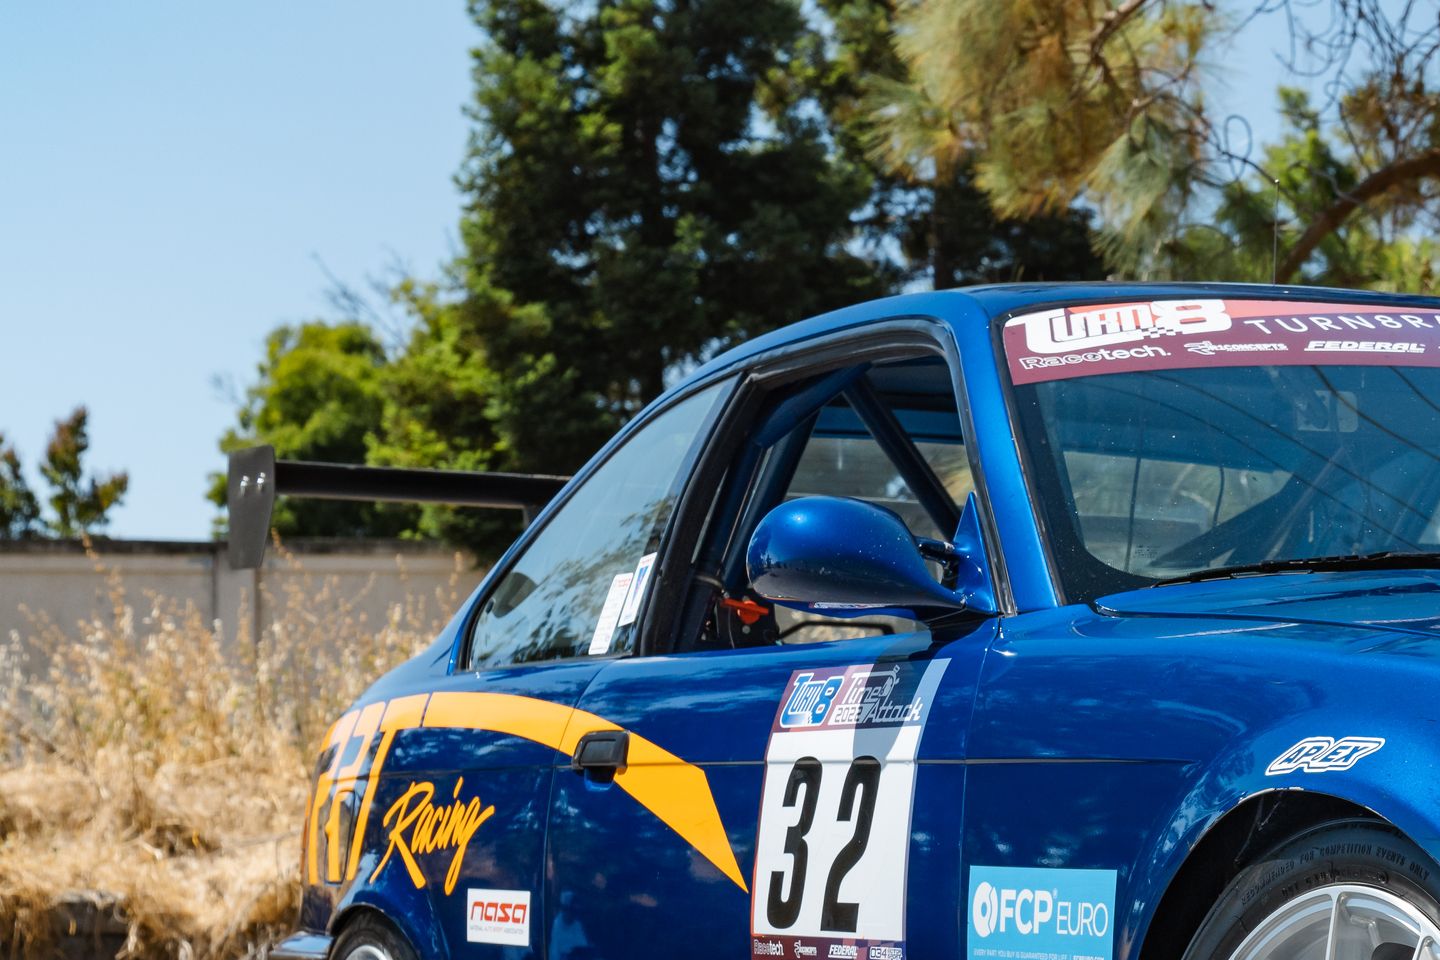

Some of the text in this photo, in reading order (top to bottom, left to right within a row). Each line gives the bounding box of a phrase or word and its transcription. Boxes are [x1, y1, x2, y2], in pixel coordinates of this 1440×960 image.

[1304, 341, 1425, 352] FEDERAL
[834, 706, 863, 723] 2022
[369, 776, 495, 895] Racing
[767, 756, 882, 932] 32
[1409, 861, 1431, 881] ONLY
[999, 889, 1109, 937] FCP EURO
[828, 944, 858, 956] FEDERAL
